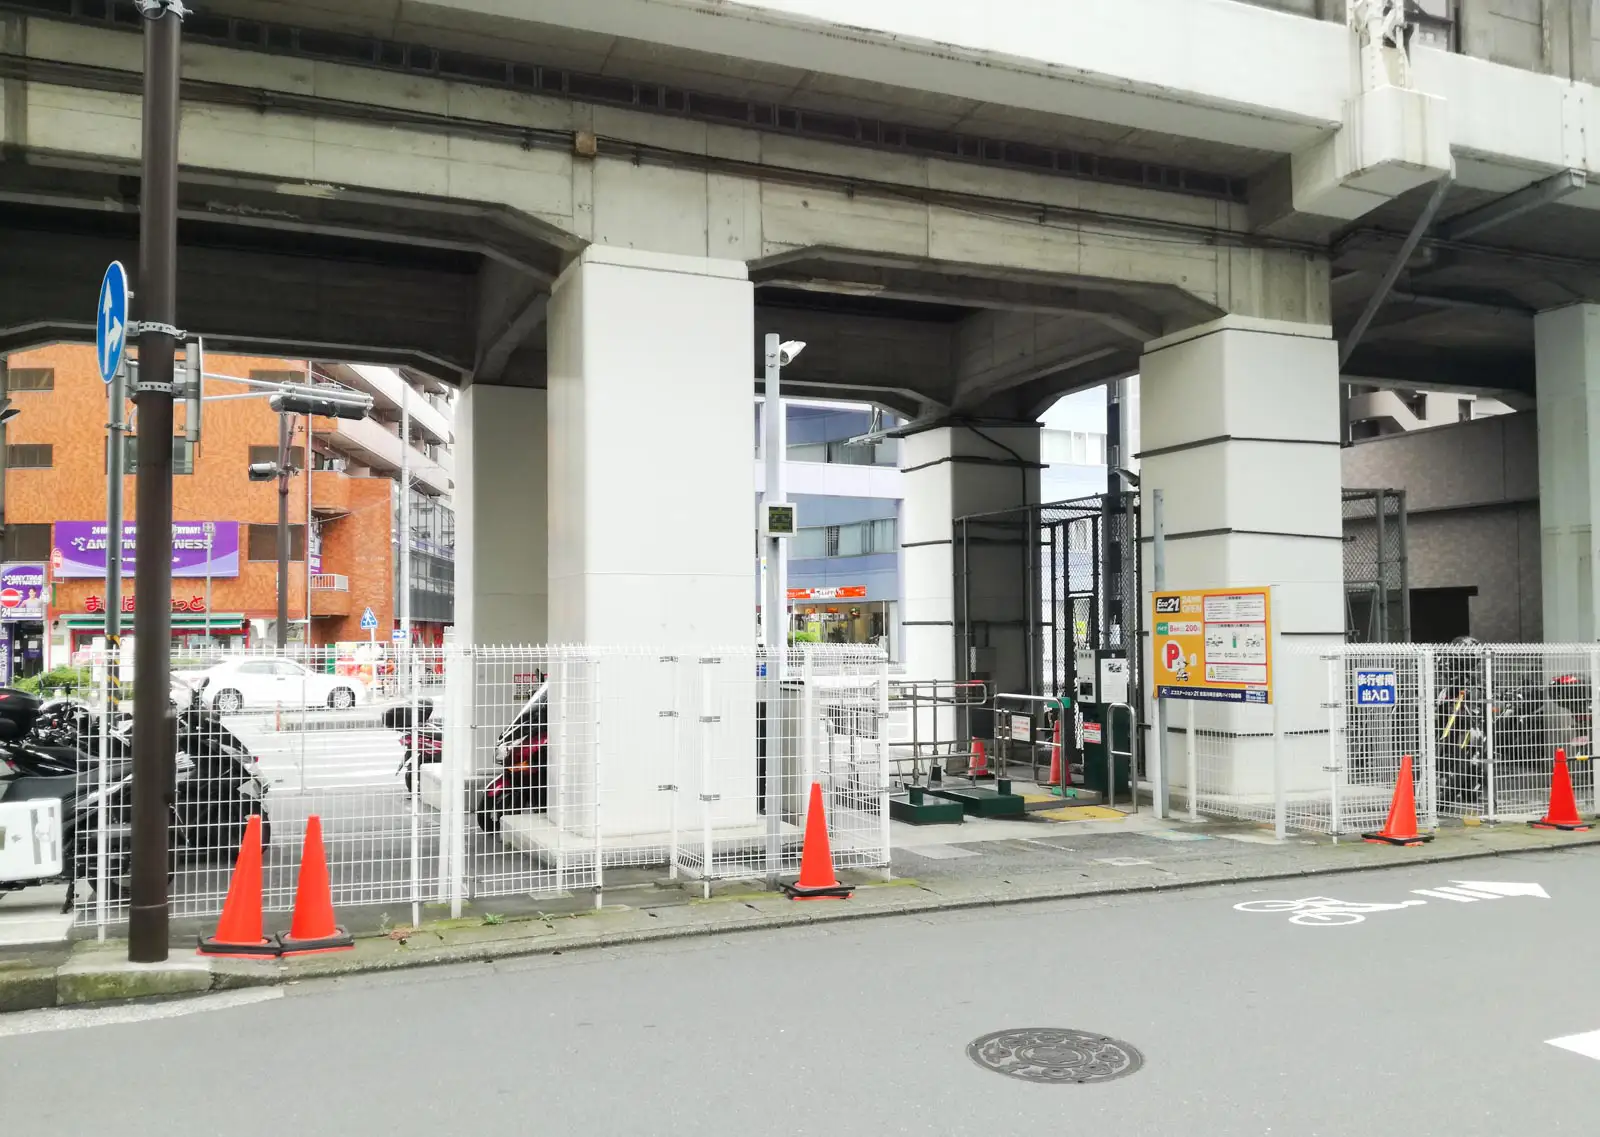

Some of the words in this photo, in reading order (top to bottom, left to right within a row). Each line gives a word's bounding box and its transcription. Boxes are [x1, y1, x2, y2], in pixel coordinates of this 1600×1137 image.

[1166, 643, 1179, 669] P
[1362, 689, 1389, 702] 出入口
